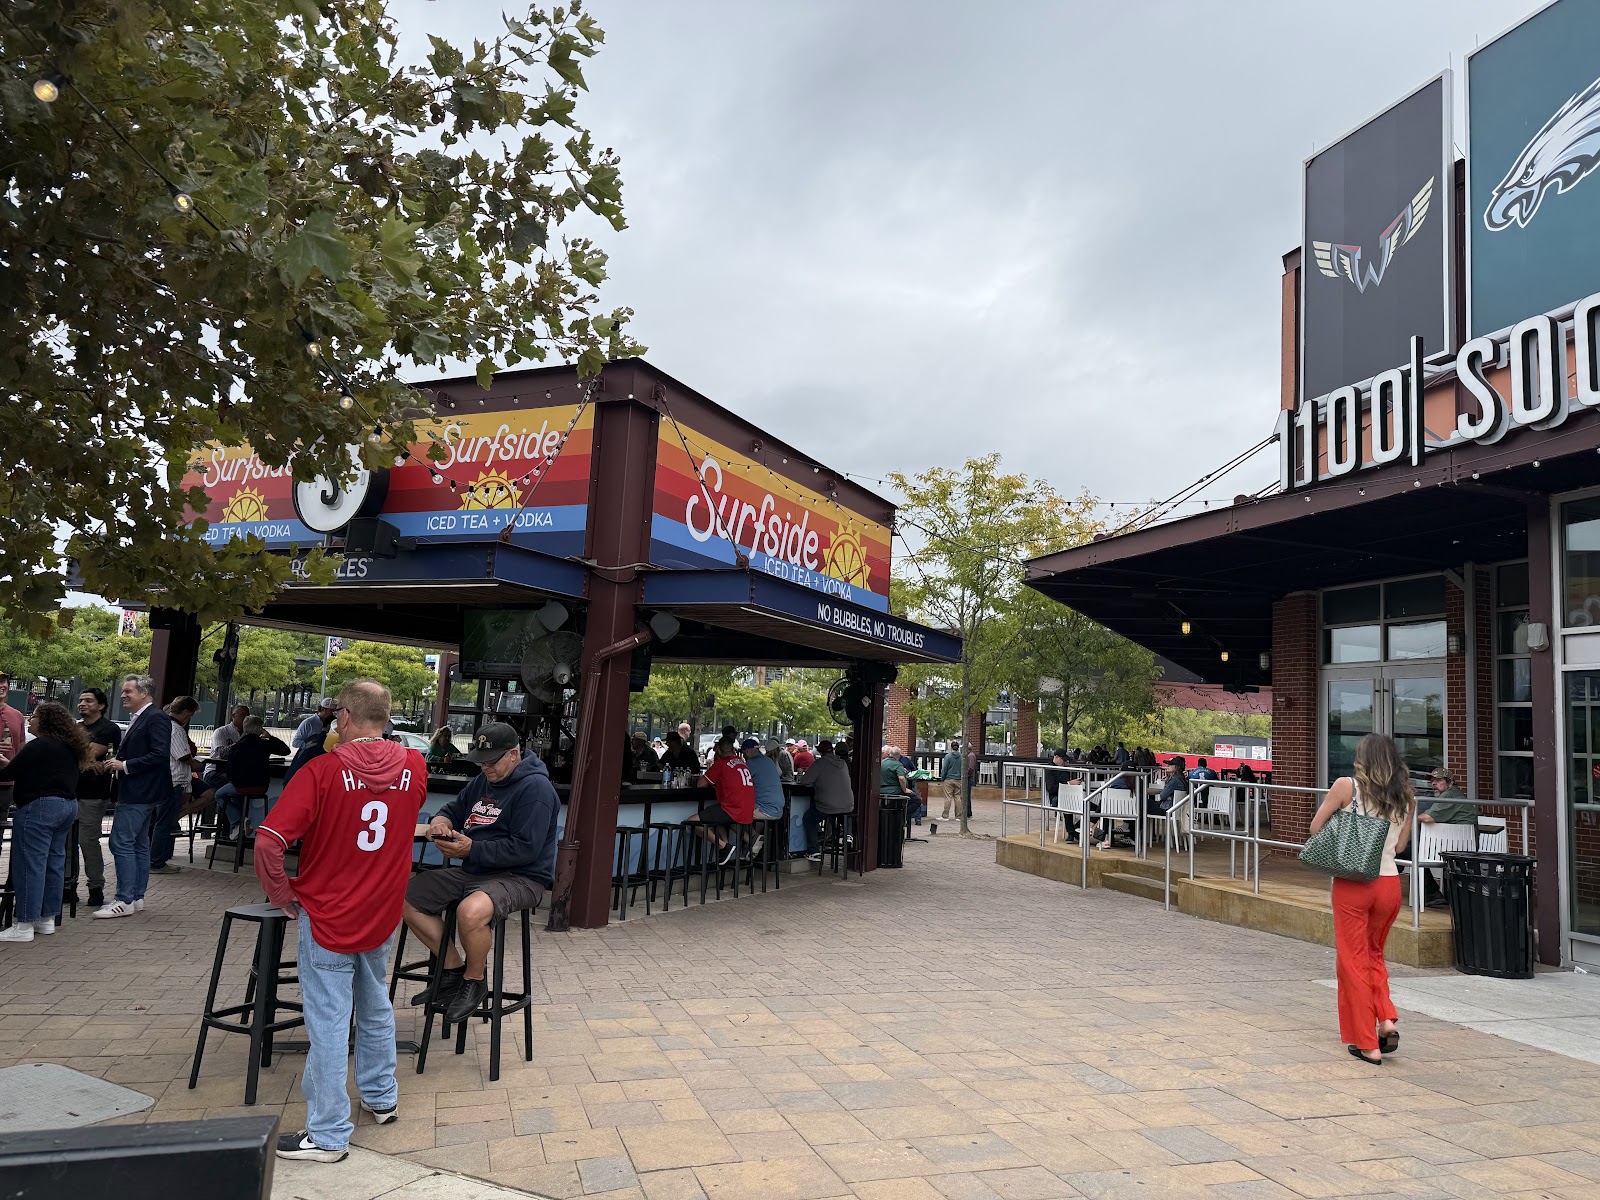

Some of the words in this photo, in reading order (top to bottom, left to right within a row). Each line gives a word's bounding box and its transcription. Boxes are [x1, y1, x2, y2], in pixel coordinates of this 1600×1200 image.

[434, 420, 560, 470] Surfside
[254, 525, 291, 539] VODKA
[427, 516, 456, 530] ICED
[461, 514, 488, 529] TEA
[505, 512, 553, 528] VODKA
[686, 458, 819, 570] Surfside
[764, 556, 788, 580] ICED
[791, 566, 811, 588] TEA
[822, 576, 852, 601] VODKA
[817, 602, 831, 622] NO
[833, 607, 872, 636] BUBBLES,
[873, 620, 886, 638] NO
[736, 767, 754, 787] 12
[357, 800, 388, 852] 3
